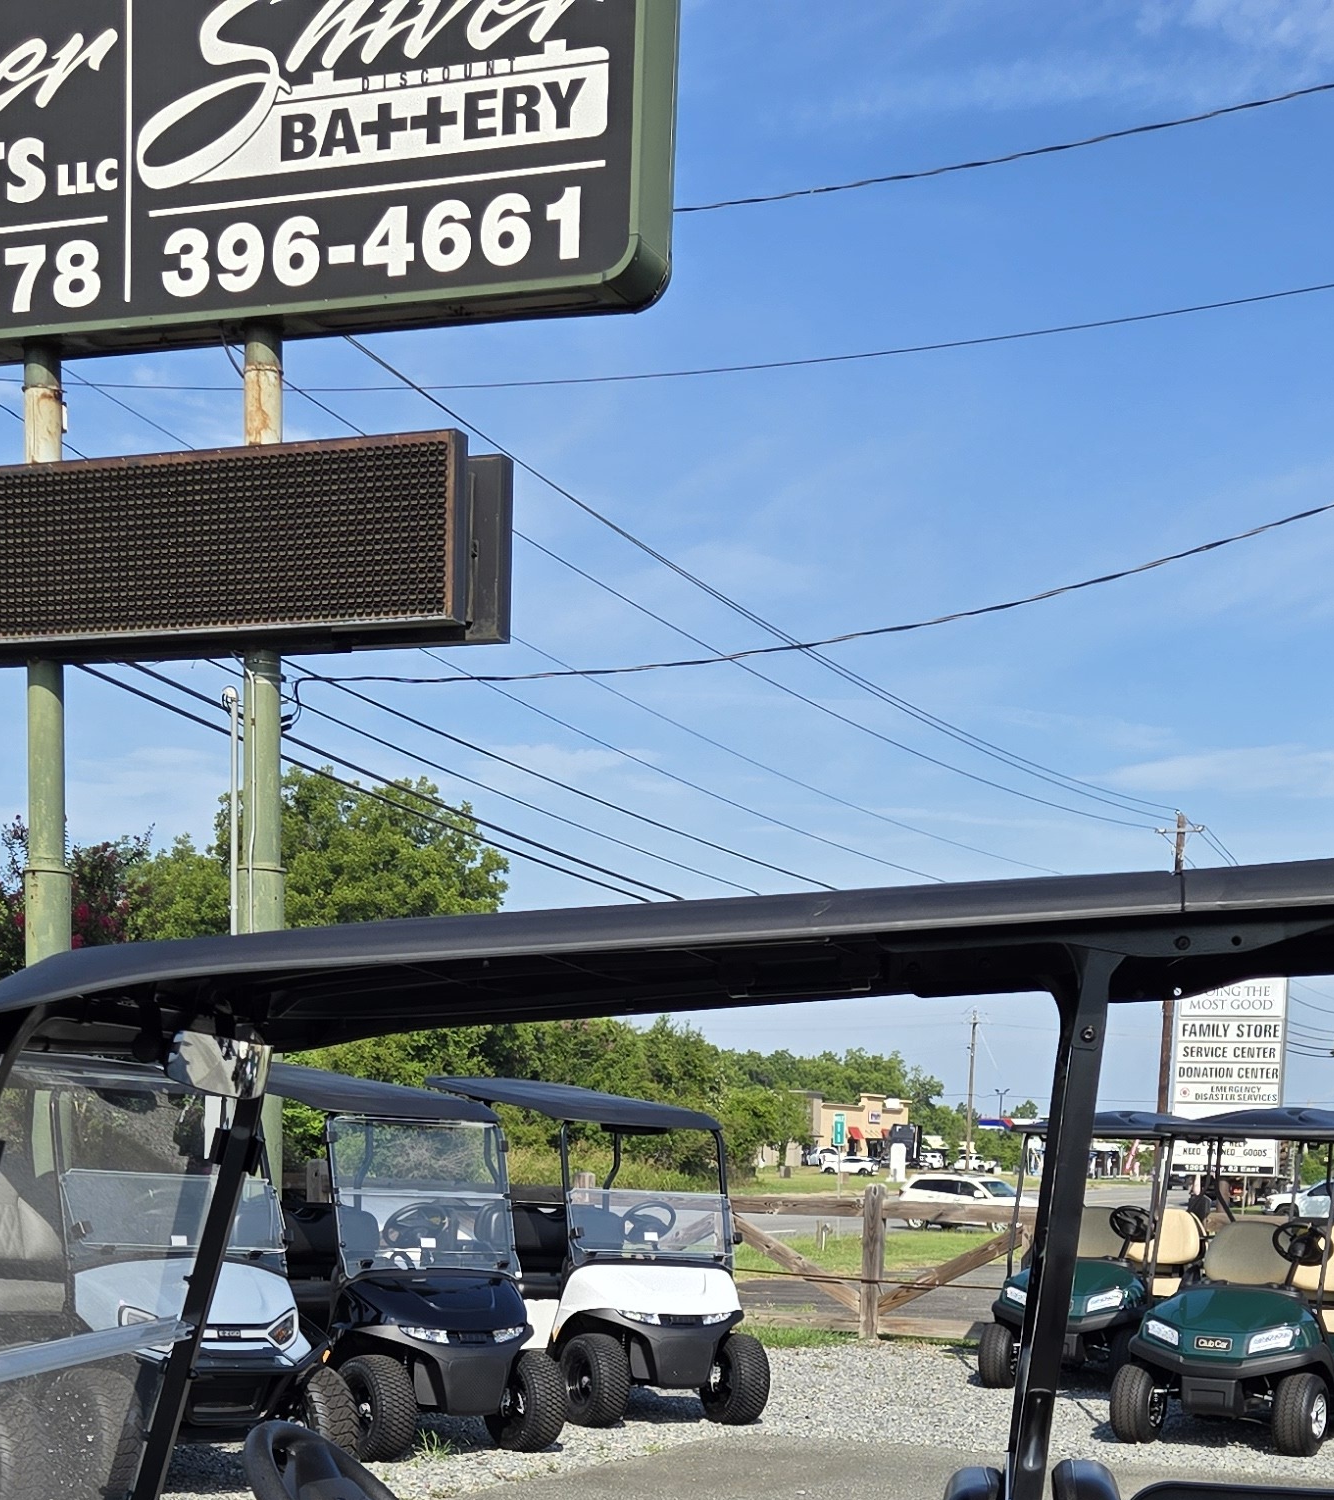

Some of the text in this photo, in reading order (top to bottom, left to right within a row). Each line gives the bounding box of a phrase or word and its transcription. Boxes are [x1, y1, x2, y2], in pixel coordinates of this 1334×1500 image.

[361, 56, 516, 93] DISCOUNT
[56, 158, 119, 197] LLC
[161, 185, 582, 299] 396-4661
[1205, 985, 1271, 997] OING THE
[1188, 1000, 1274, 1011] MOST GOOD
[1181, 1023, 1281, 1038] FAMILY STORE
[1182, 1046, 1277, 1059] SERVICE CENTER
[1178, 1066, 1279, 1080] DONATION CENTER
[1210, 1085, 1262, 1094] EMERGENCY
[1194, 1092, 1279, 1102] DISASTER SERVICES
[1242, 1149, 1268, 1157] GOODS
